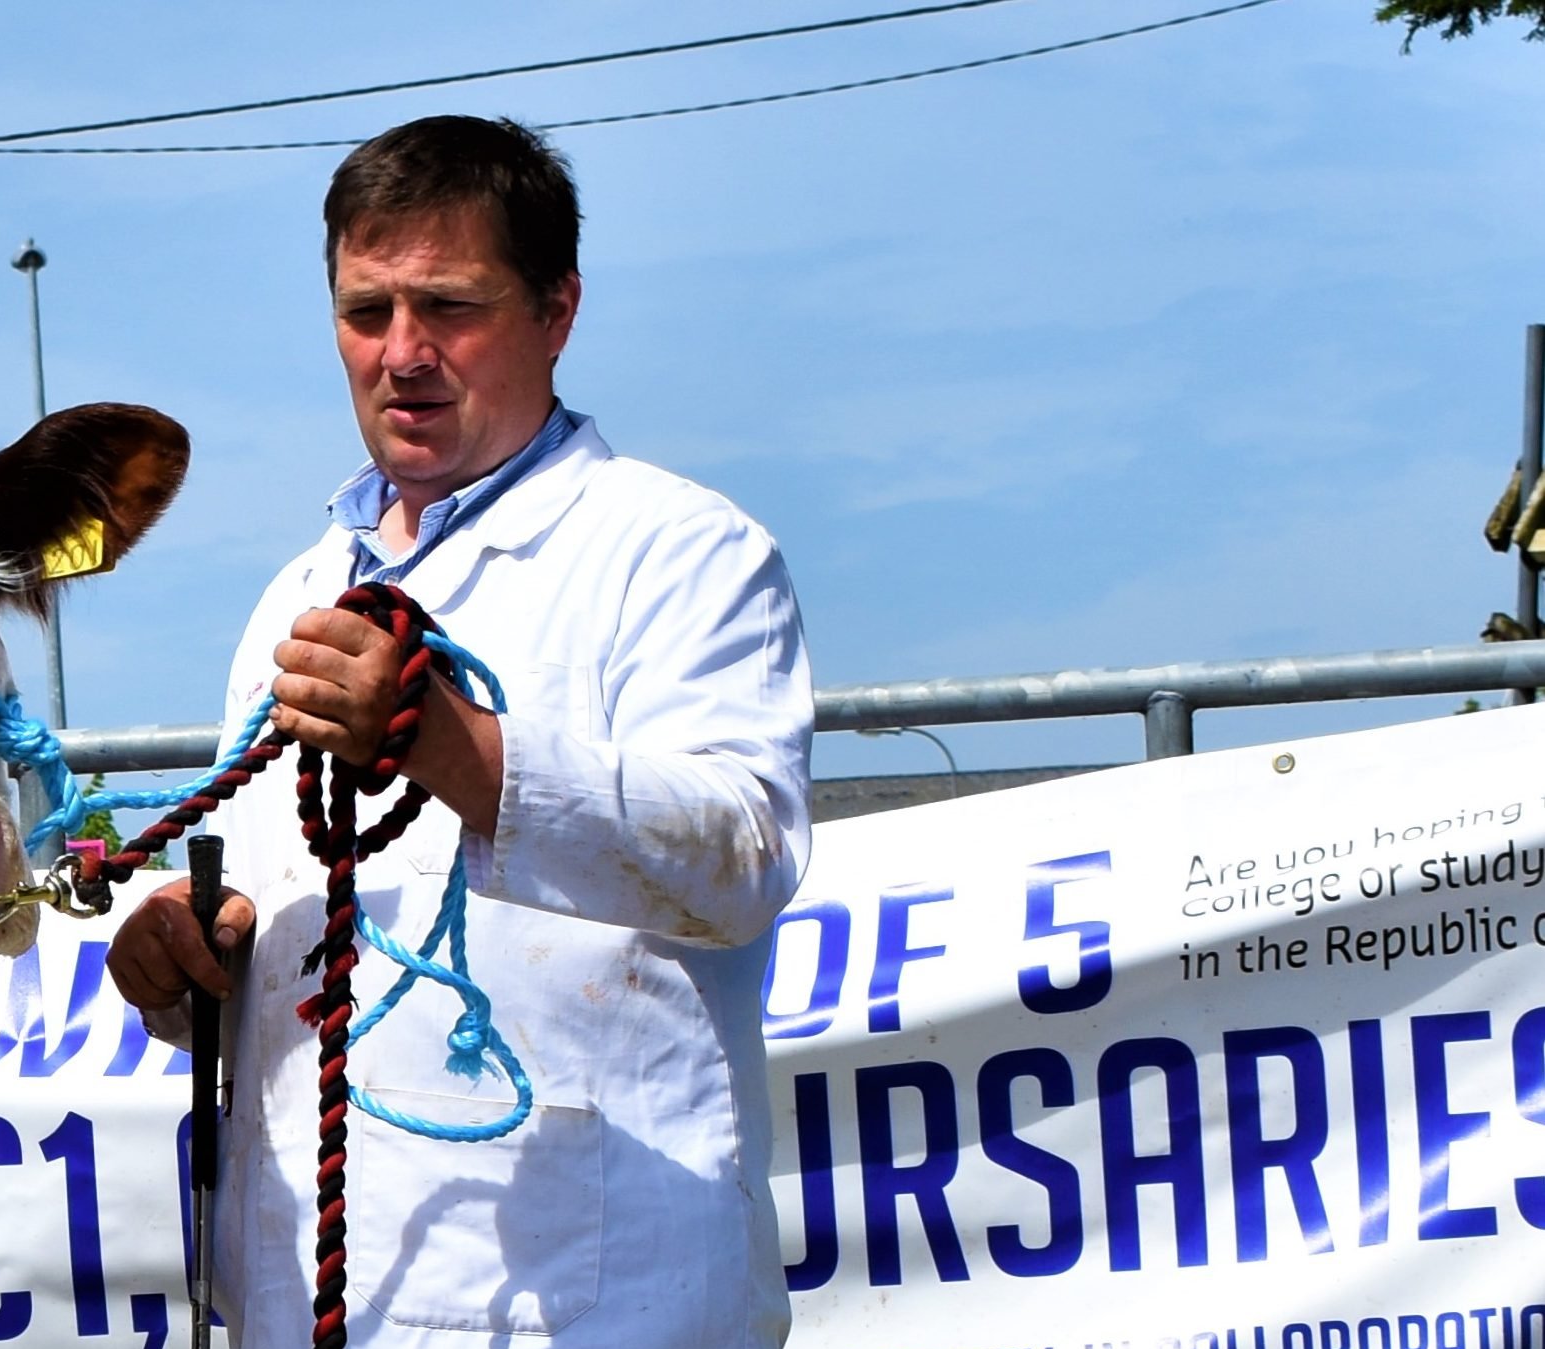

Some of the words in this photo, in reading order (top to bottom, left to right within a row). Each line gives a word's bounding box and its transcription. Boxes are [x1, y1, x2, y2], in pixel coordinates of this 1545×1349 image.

[1181, 872, 1342, 917] college
[1358, 863, 1404, 899] or
[1419, 839, 1545, 893] study
[1184, 854, 1257, 892] Are
[1274, 839, 1354, 876] you
[1373, 801, 1523, 849] hoping
[761, 880, 955, 1039] OF
[1017, 849, 1113, 1015] 5
[1178, 942, 1220, 981] in
[1236, 935, 1309, 974] the
[1325, 906, 1518, 972] Republic
